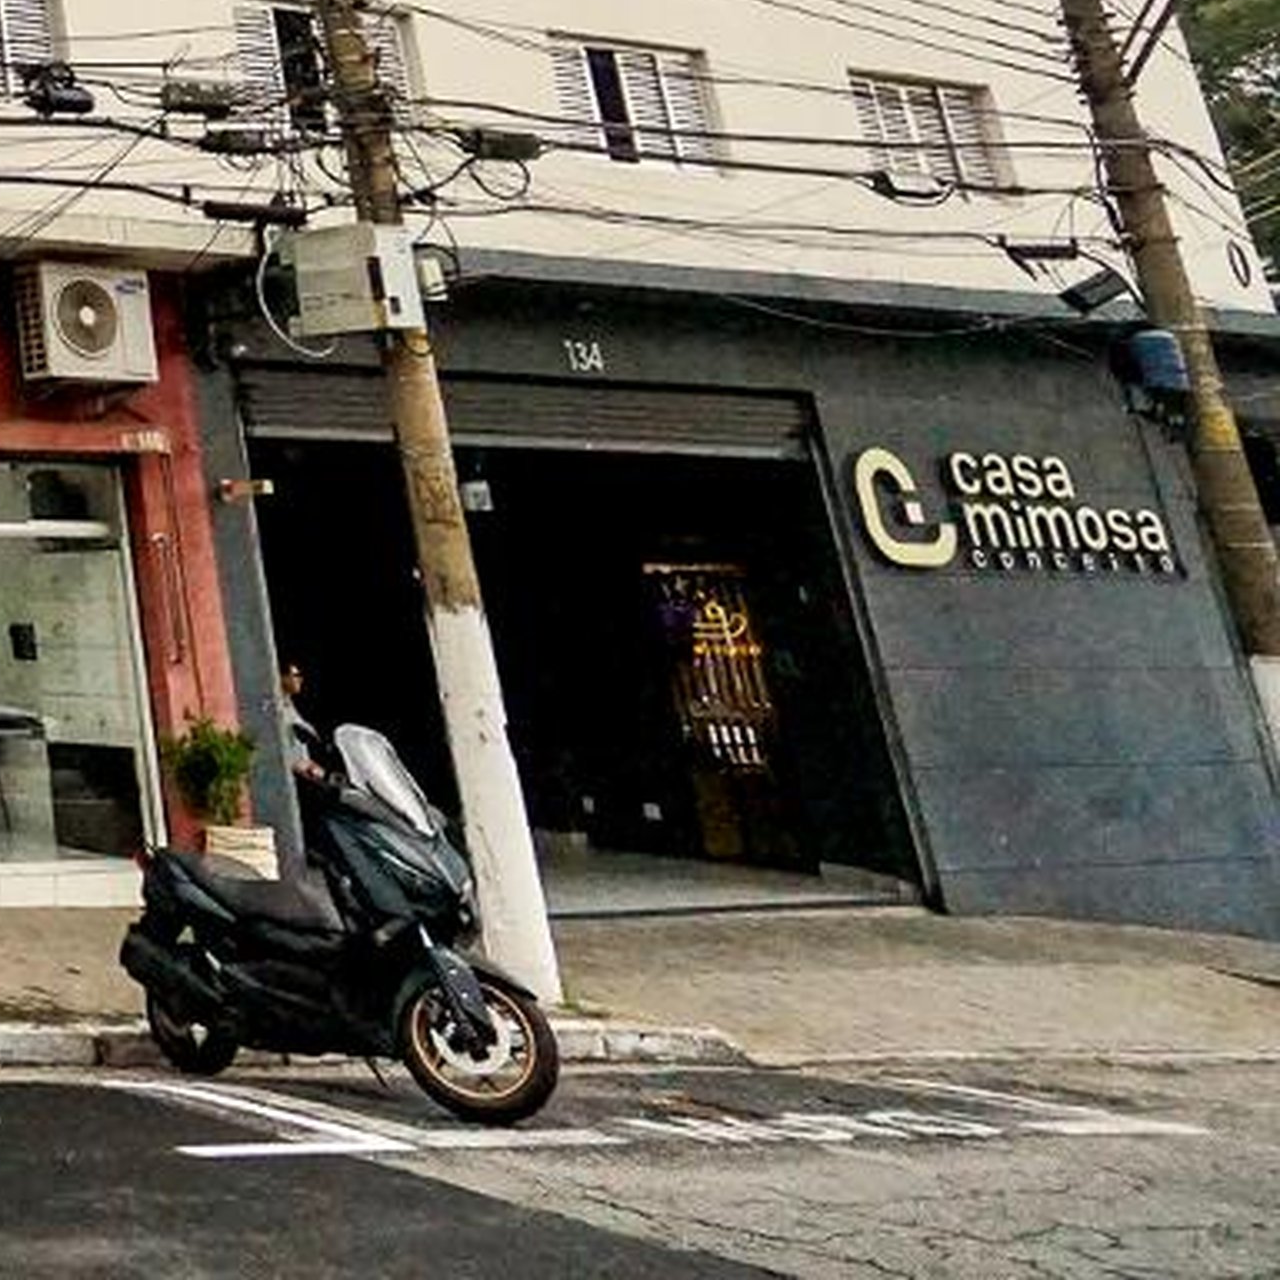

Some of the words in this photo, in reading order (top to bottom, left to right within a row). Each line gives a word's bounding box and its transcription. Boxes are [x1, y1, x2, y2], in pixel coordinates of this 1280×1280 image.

[564, 339, 604, 372] 134
[950, 452, 1075, 499] casa
[962, 500, 1170, 553] mimosa
